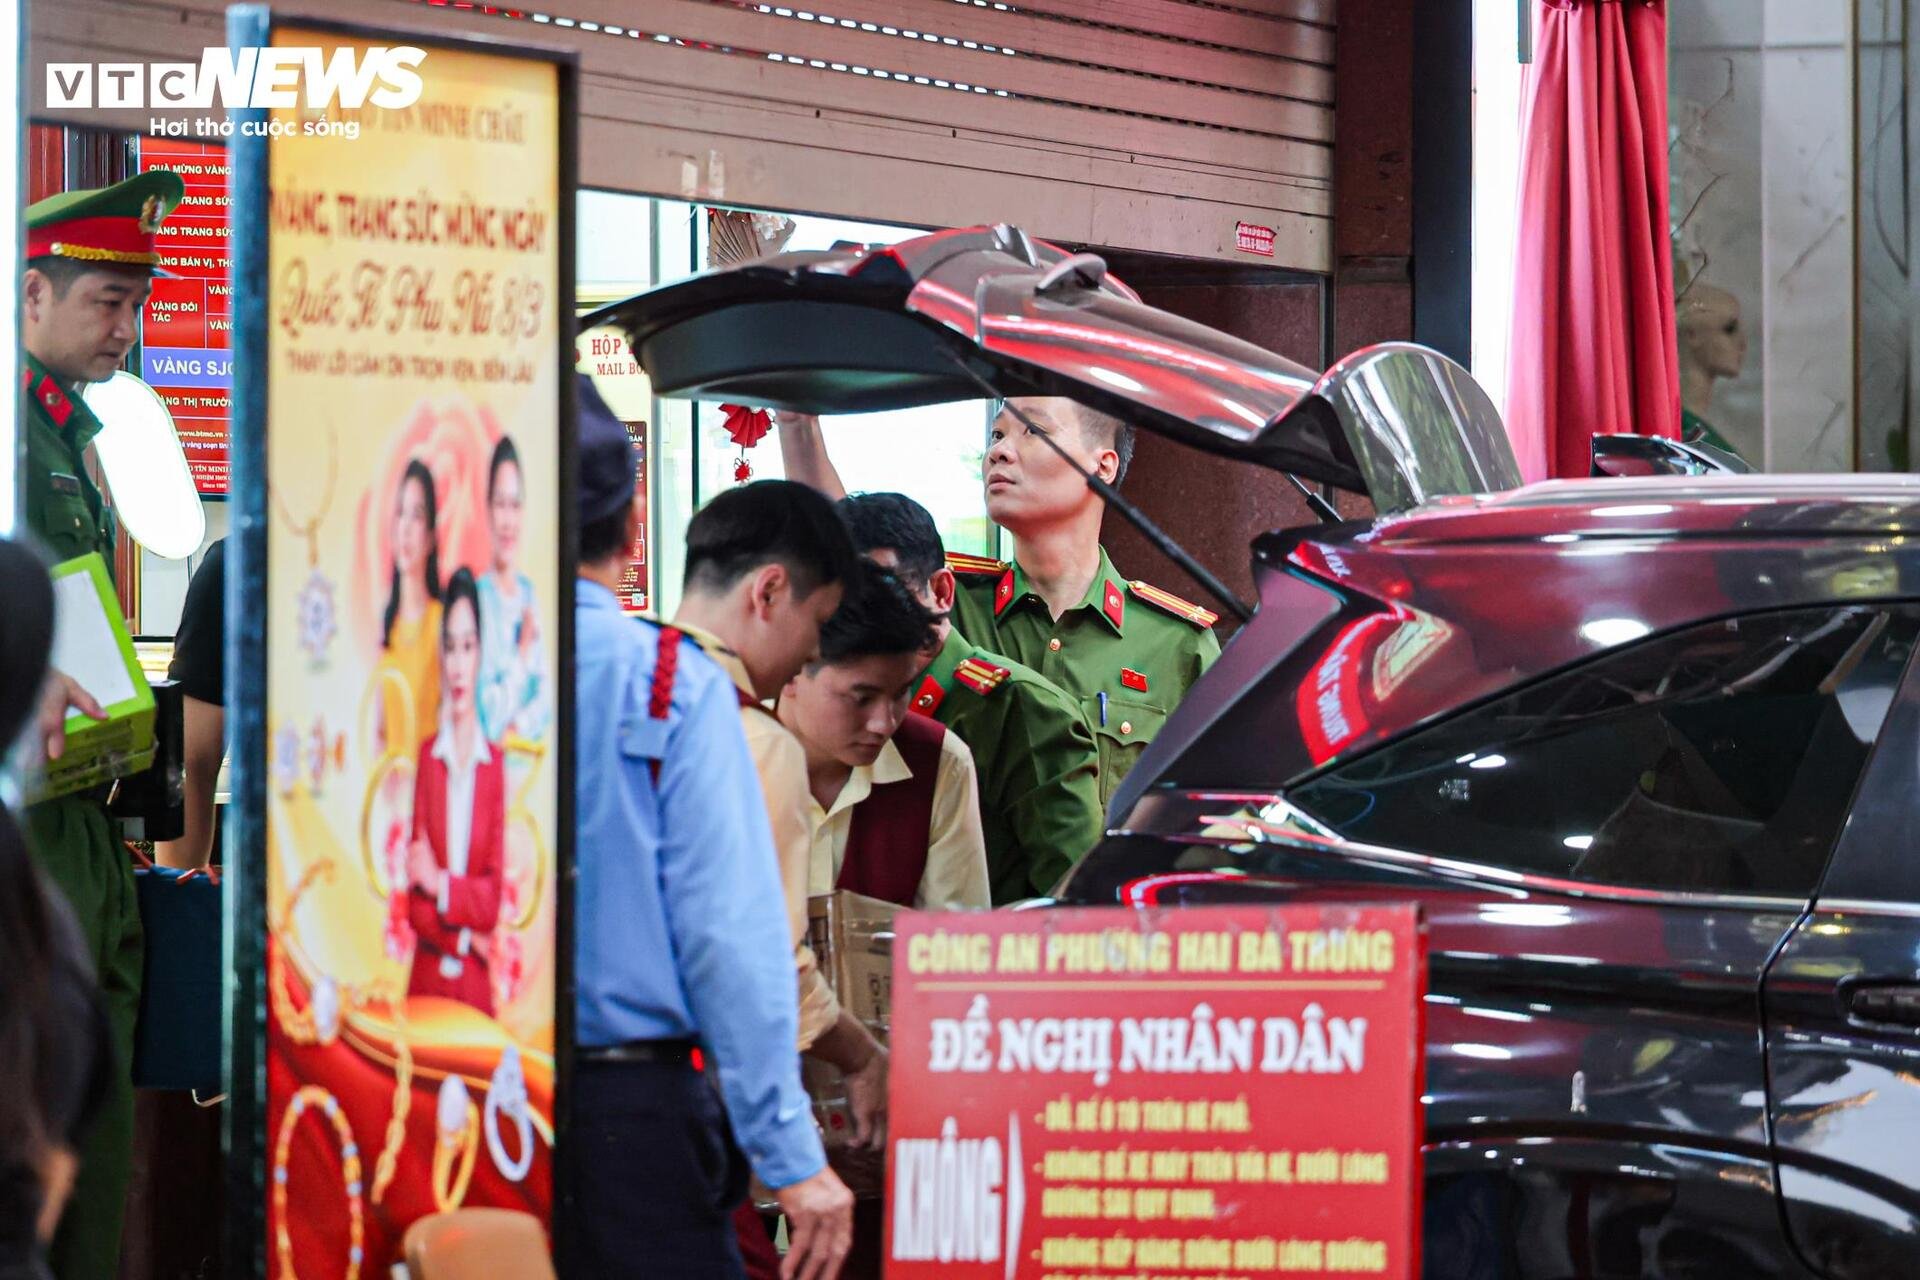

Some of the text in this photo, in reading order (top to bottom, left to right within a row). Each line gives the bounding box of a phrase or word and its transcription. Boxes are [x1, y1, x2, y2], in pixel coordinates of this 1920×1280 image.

[172, 163, 203, 175] MỪNG
[204, 164, 232, 175] VÀNG
[180, 227, 213, 236] TRANG
[151, 300, 179, 312] VÀNG
[152, 312, 171, 322] TÁC
[591, 334, 622, 359] HỘP
[151, 356, 202, 375] VÀNG
[597, 362, 645, 375] MAIL BO
[182, 397, 198, 408] THỊ
[908, 927, 990, 973] CÔNG
[997, 932, 1040, 973] AN
[1178, 931, 1232, 971] HAI
[998, 1018, 1113, 1087] NGHỊ
[1119, 1003, 1255, 1073] NHÂN
[1261, 1003, 1367, 1073] DÂN
[893, 1116, 1002, 1264] KHÔNG
